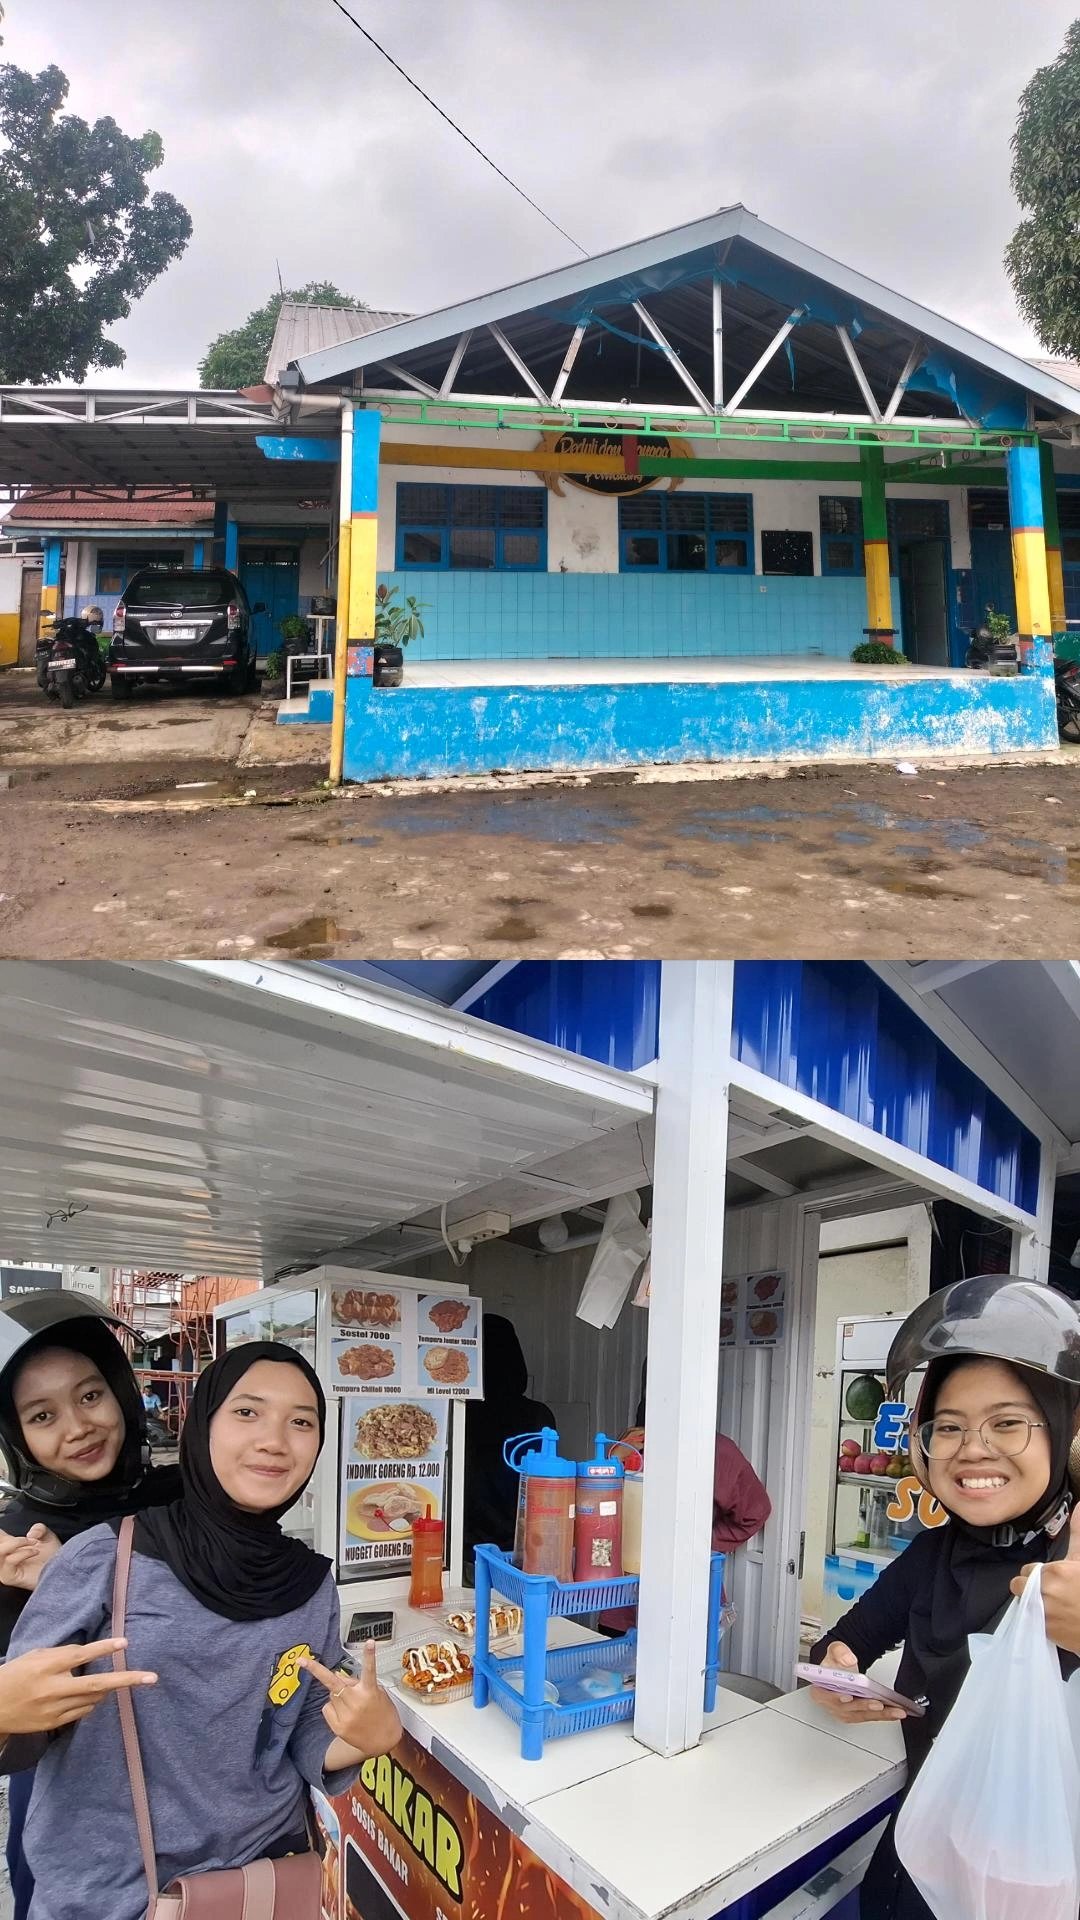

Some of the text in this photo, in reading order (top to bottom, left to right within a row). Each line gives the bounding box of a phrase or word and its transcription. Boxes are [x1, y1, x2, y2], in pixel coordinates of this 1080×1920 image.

[369, 1331, 390, 1340] 7000
[346, 1463, 377, 1480] INDOMIE
[378, 1463, 406, 1478] GORENG
[418, 1462, 440, 1478] 12.000
[345, 1545, 373, 1561] NUGGET
[373, 1542, 402, 1558] GORENG
[361, 1754, 461, 1896] BAKAR
[351, 1796, 409, 1886] SOSIS BAKAR
